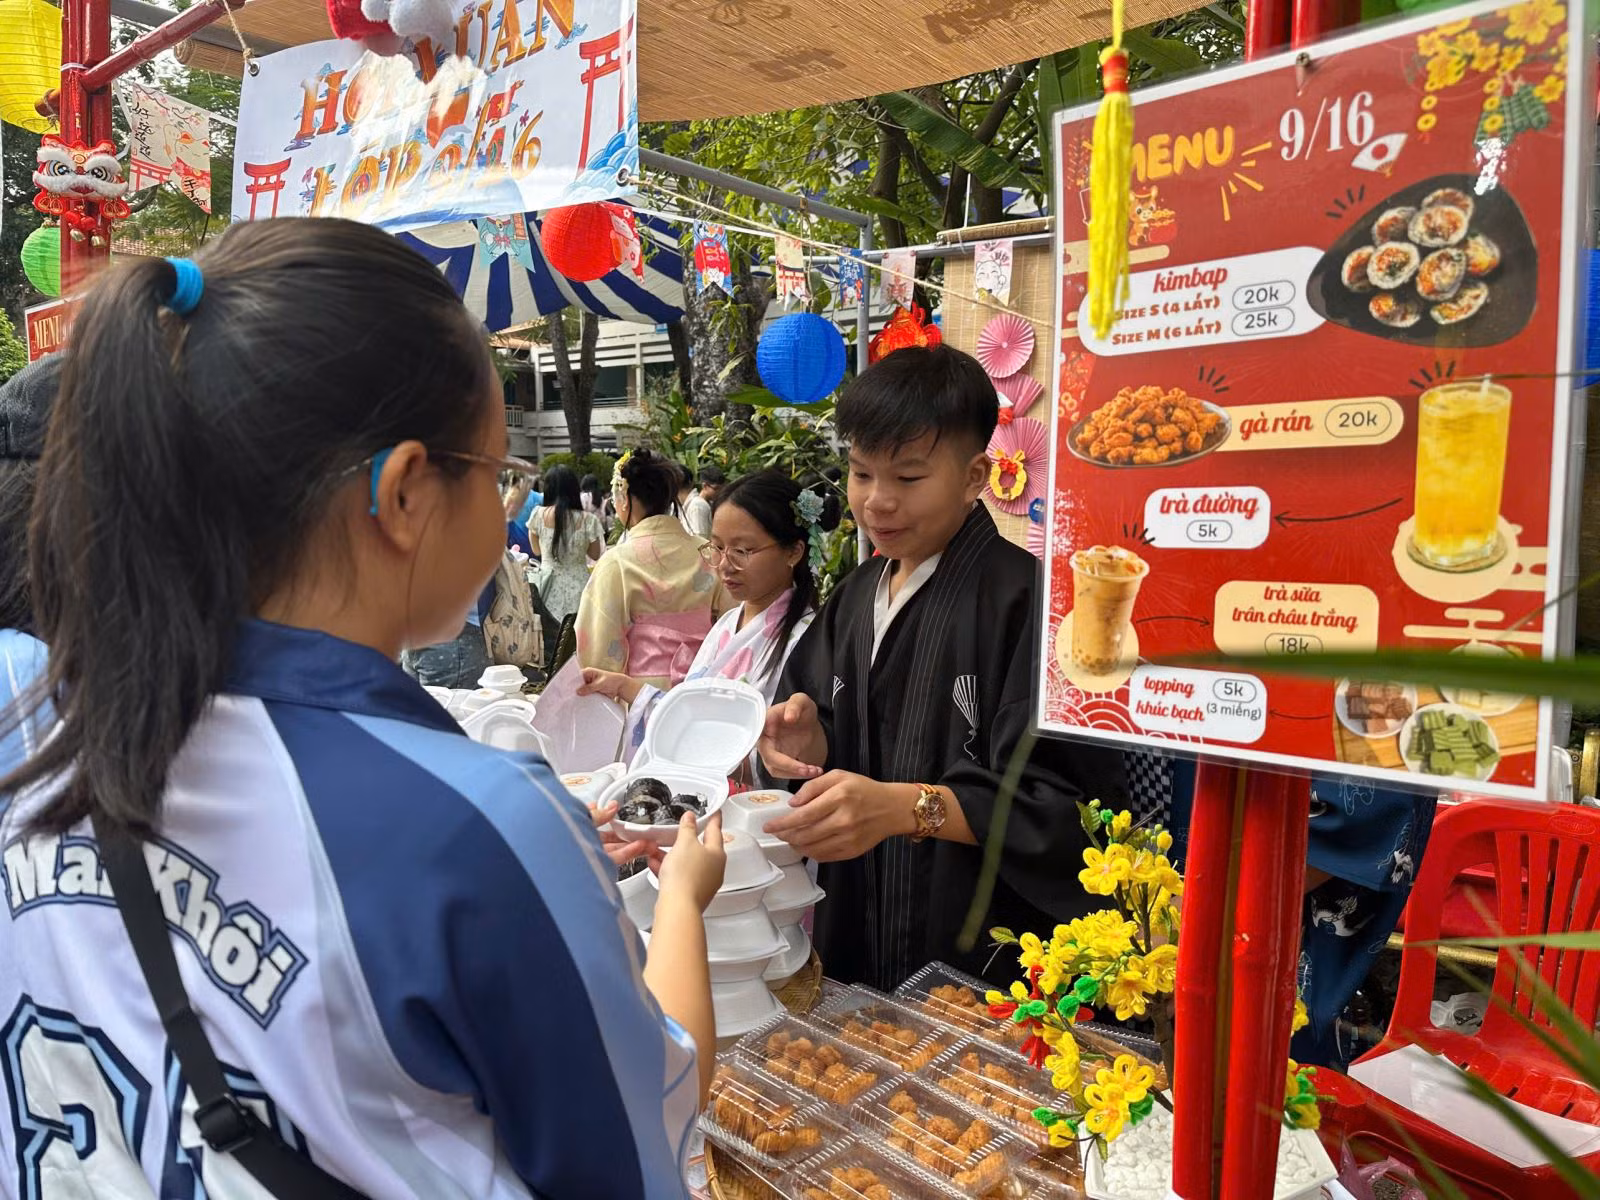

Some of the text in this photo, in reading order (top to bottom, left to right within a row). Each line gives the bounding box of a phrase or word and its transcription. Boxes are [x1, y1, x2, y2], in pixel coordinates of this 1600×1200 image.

[1280, 91, 1374, 161] 9/16
[1153, 267, 1229, 293] kimbap
[1150, 303, 1159, 316] S
[1163, 301, 1179, 315] (4
[1184, 292, 1221, 312] LÁT)
[1244, 288, 1279, 304] 20k
[1112, 312, 1278, 345] SIZE M (6 LÁT) 25k
[1239, 409, 1377, 441] gà rán 20k
[1159, 491, 1259, 520] trà đường
[1198, 523, 1217, 538] 5k
[1263, 584, 1322, 603] trà sữa
[1232, 607, 1358, 634] trân châu trắng
[1279, 637, 1309, 655] 18k
[1144, 676, 1243, 698] topping 5k
[1135, 699, 1262, 723] khúc bạch (3 miếng)
